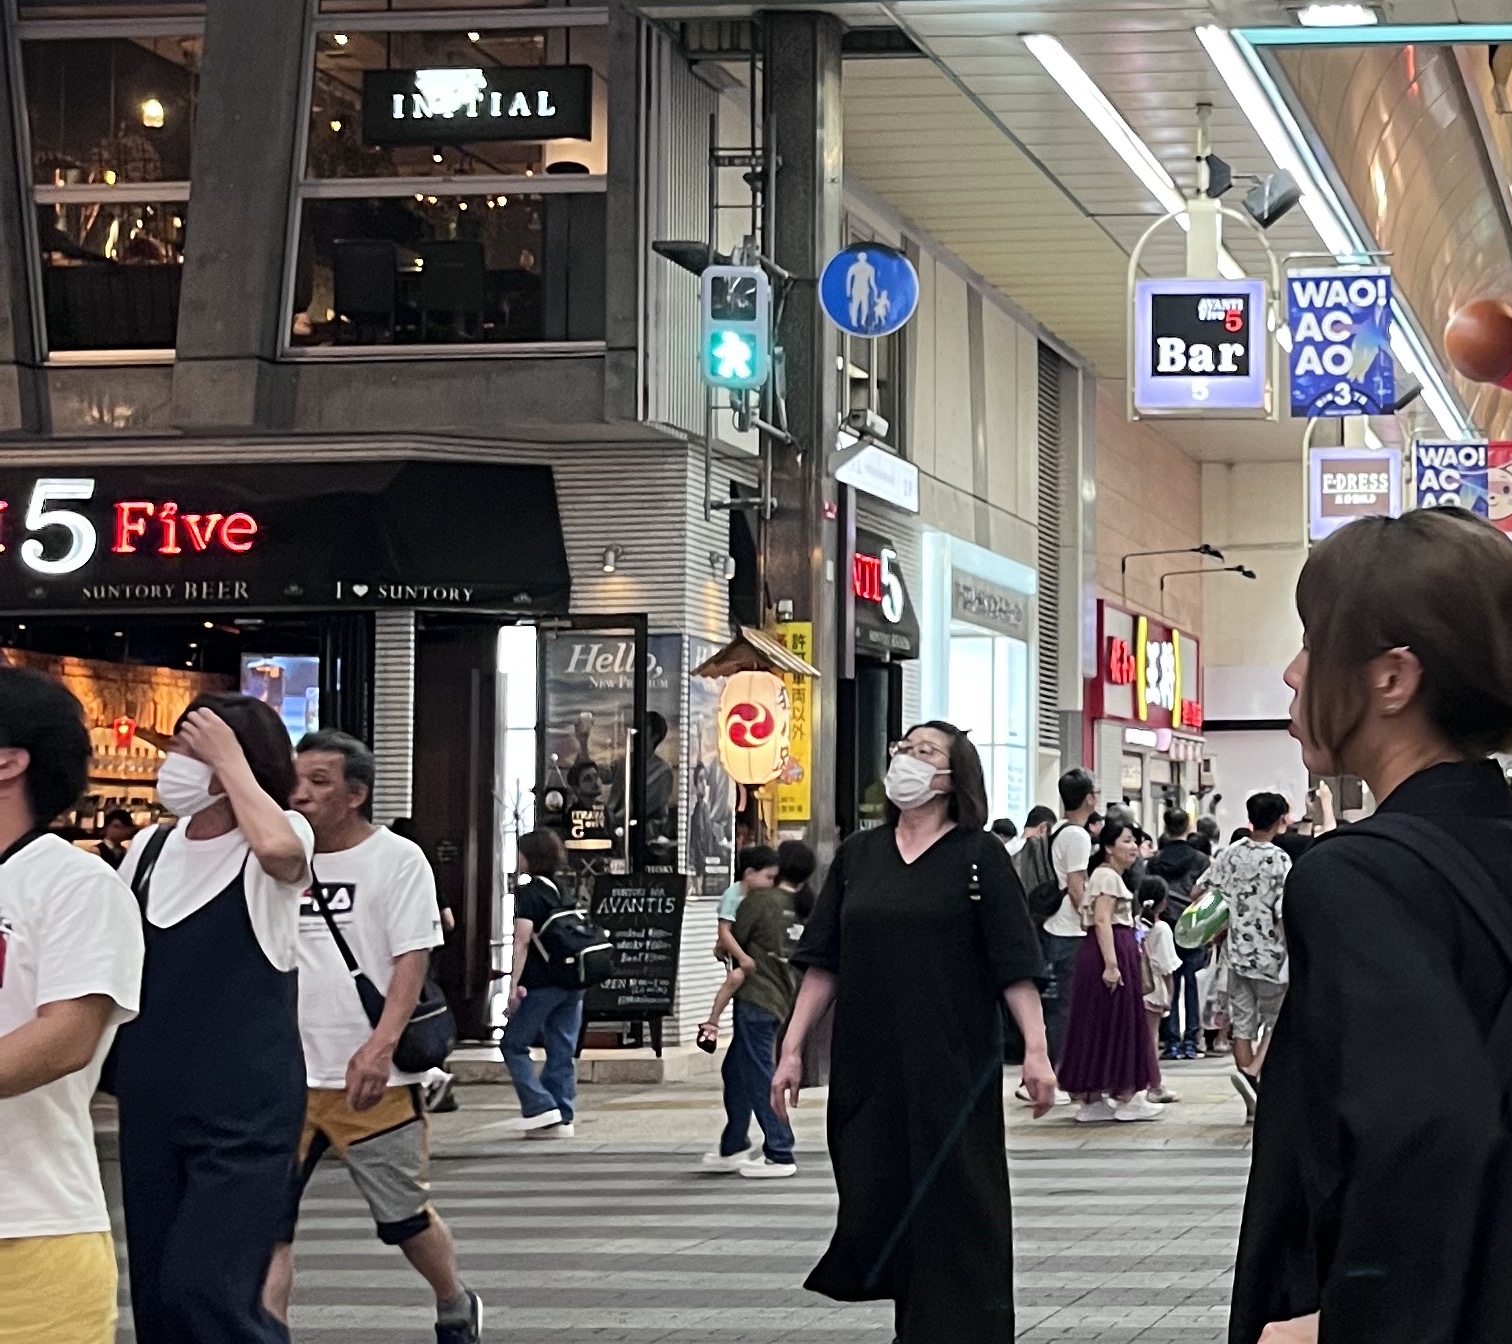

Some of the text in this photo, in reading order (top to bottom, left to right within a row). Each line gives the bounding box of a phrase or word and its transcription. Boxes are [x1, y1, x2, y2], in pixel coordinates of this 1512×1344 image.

[391, 90, 557, 119] INTIAL
[1292, 278, 1388, 309] WAO!
[1295, 310, 1353, 343] AC
[1156, 337, 1245, 373] Bar
[1295, 344, 1355, 376] AO
[1418, 447, 1487, 467] WAO!
[1420, 468, 1461, 491] AC
[20, 478, 98, 575] 5
[110, 501, 258, 554] Five
[82, 582, 250, 601] SUNTORY BEER
[378, 584, 474, 602] SUNTORY
[881, 548, 904, 624] 5
